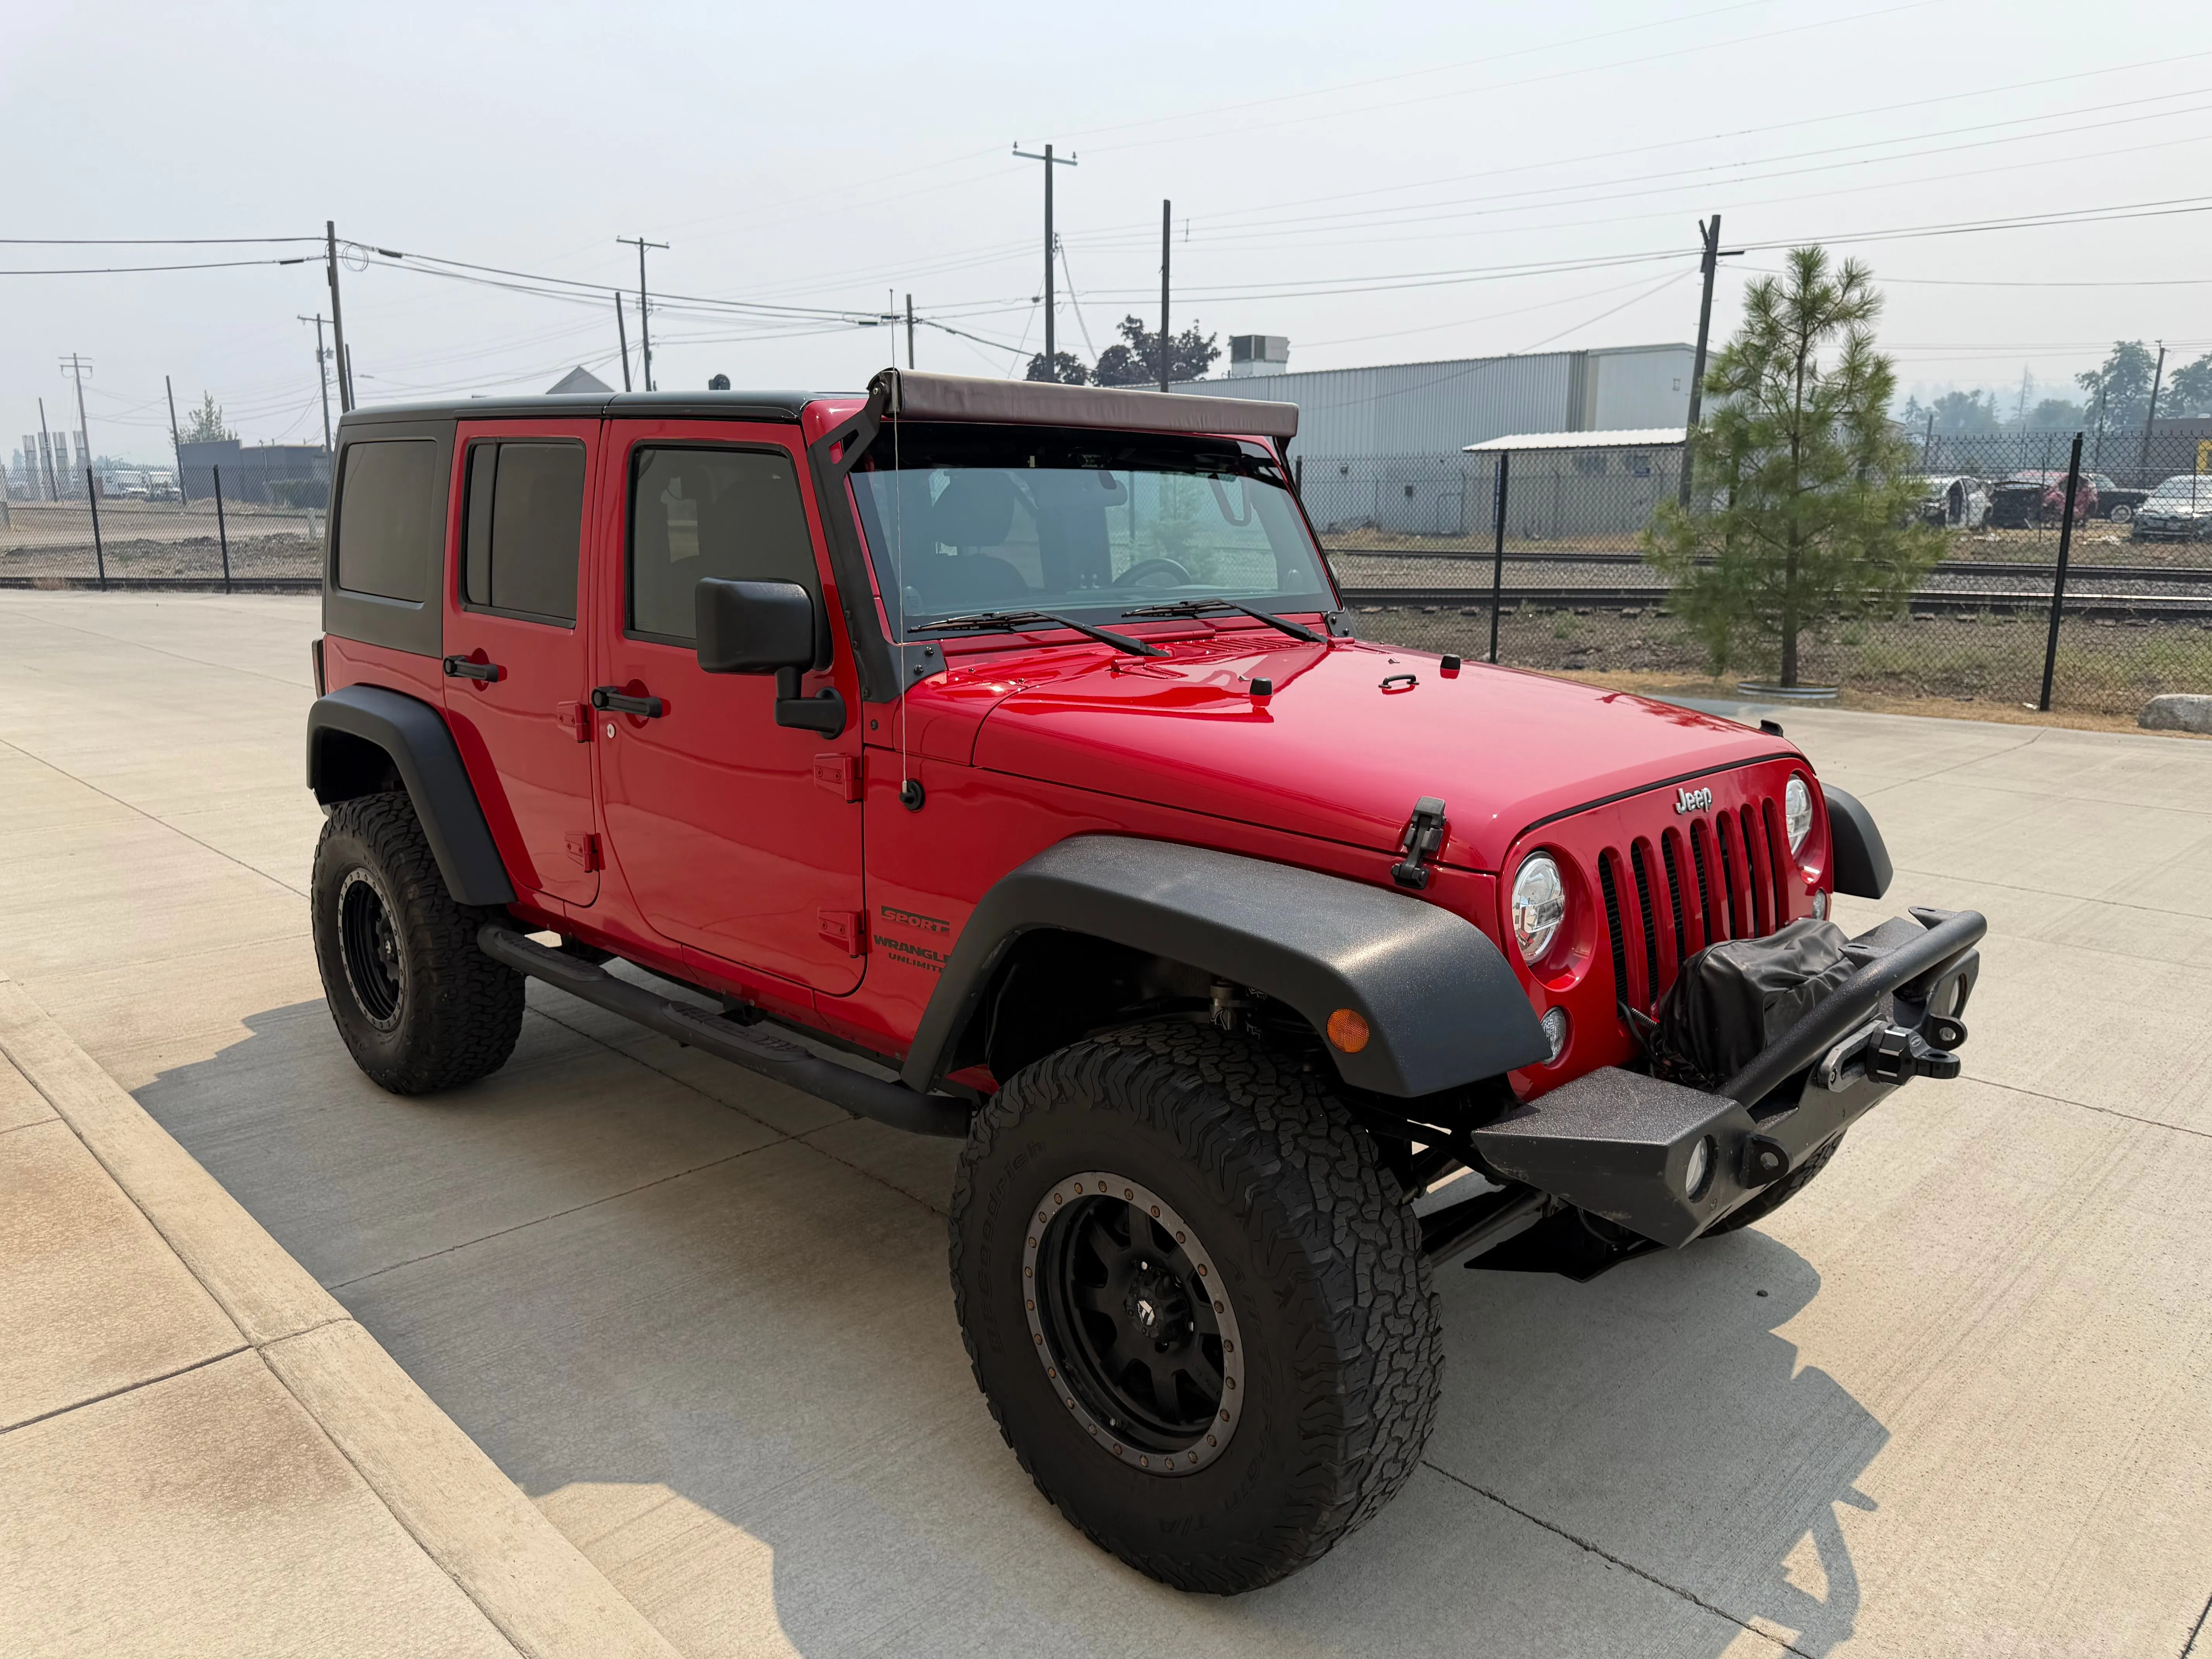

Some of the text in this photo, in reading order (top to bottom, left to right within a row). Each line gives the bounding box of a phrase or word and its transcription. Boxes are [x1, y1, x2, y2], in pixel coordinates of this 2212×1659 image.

[1675, 787, 1712, 814] Jeep
[884, 910, 950, 932] SPORT
[874, 935, 950, 963] WRANGL
[889, 952, 942, 973] UNLIMIT
